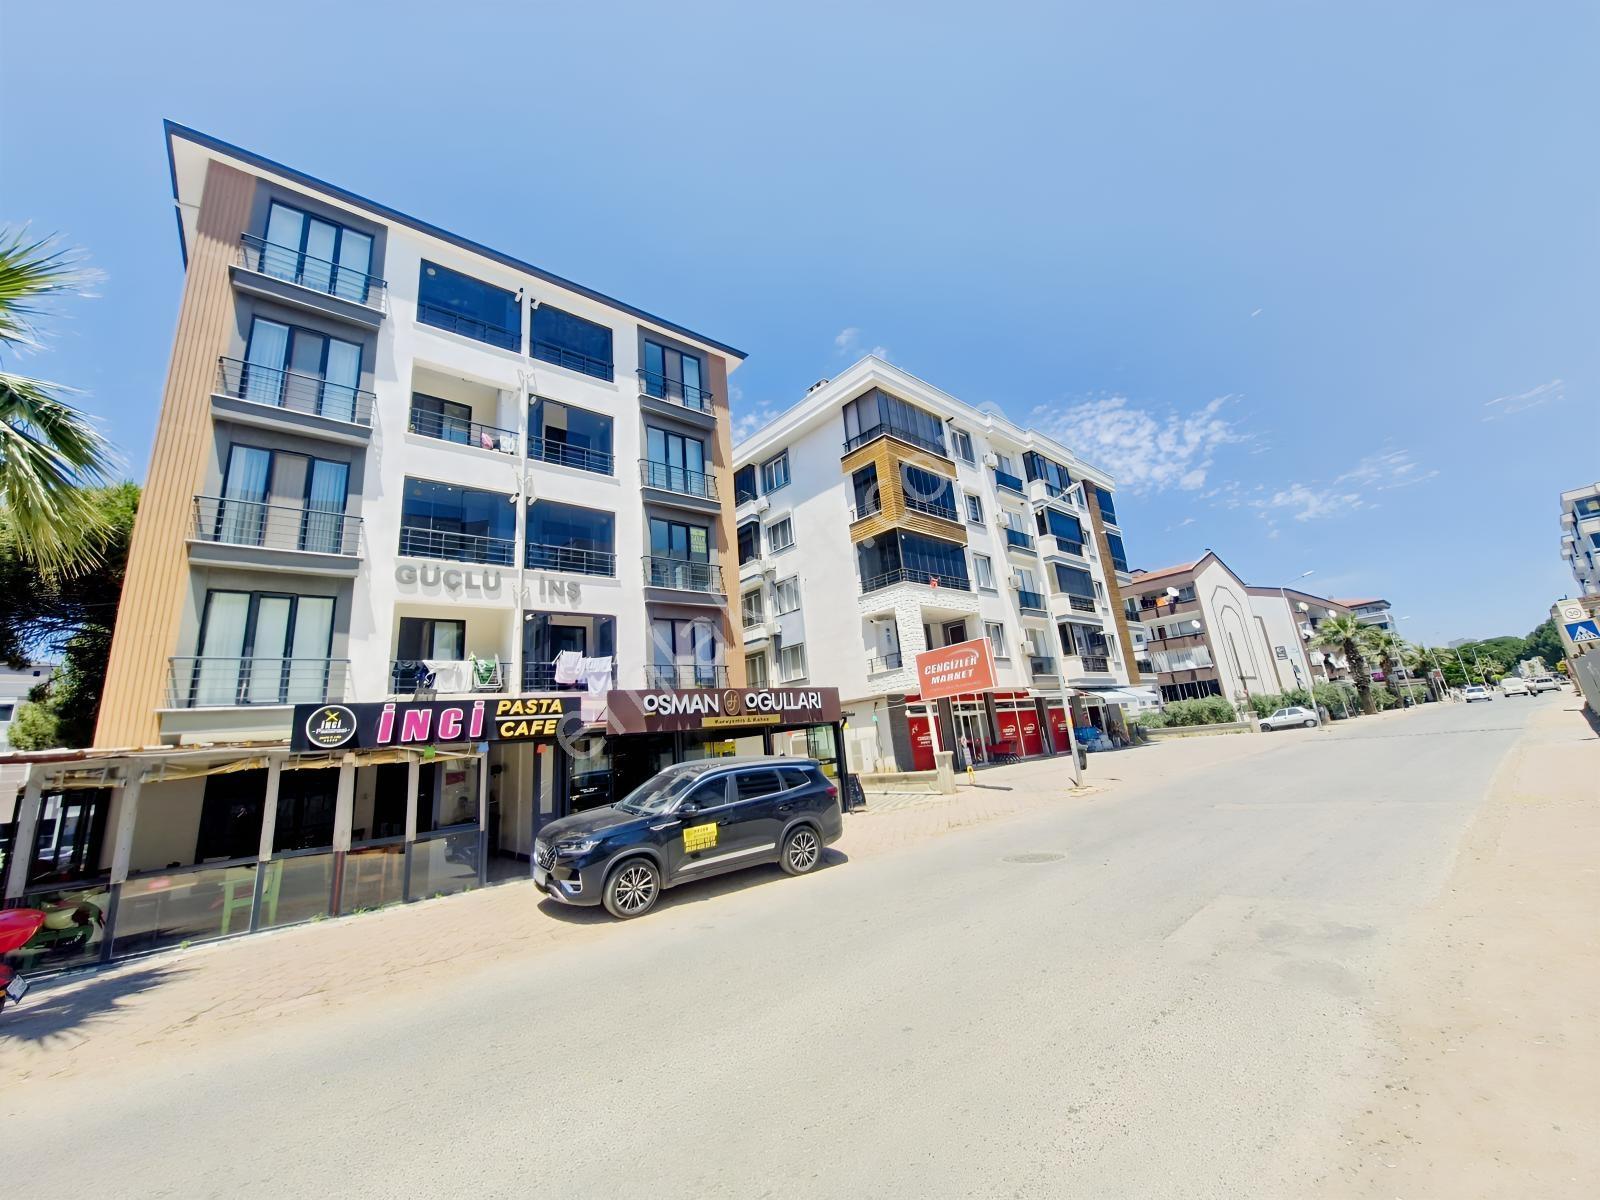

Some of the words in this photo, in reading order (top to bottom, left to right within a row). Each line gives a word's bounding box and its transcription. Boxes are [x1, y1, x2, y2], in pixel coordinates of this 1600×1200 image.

[394, 564, 500, 593] GÜÇLÜ
[931, 668, 974, 684] MARKET
[496, 698, 562, 715] PASTA
[644, 693, 719, 716] OSMAN
[745, 689, 821, 712] OĞULLARI
[500, 719, 557, 737] CAFE
